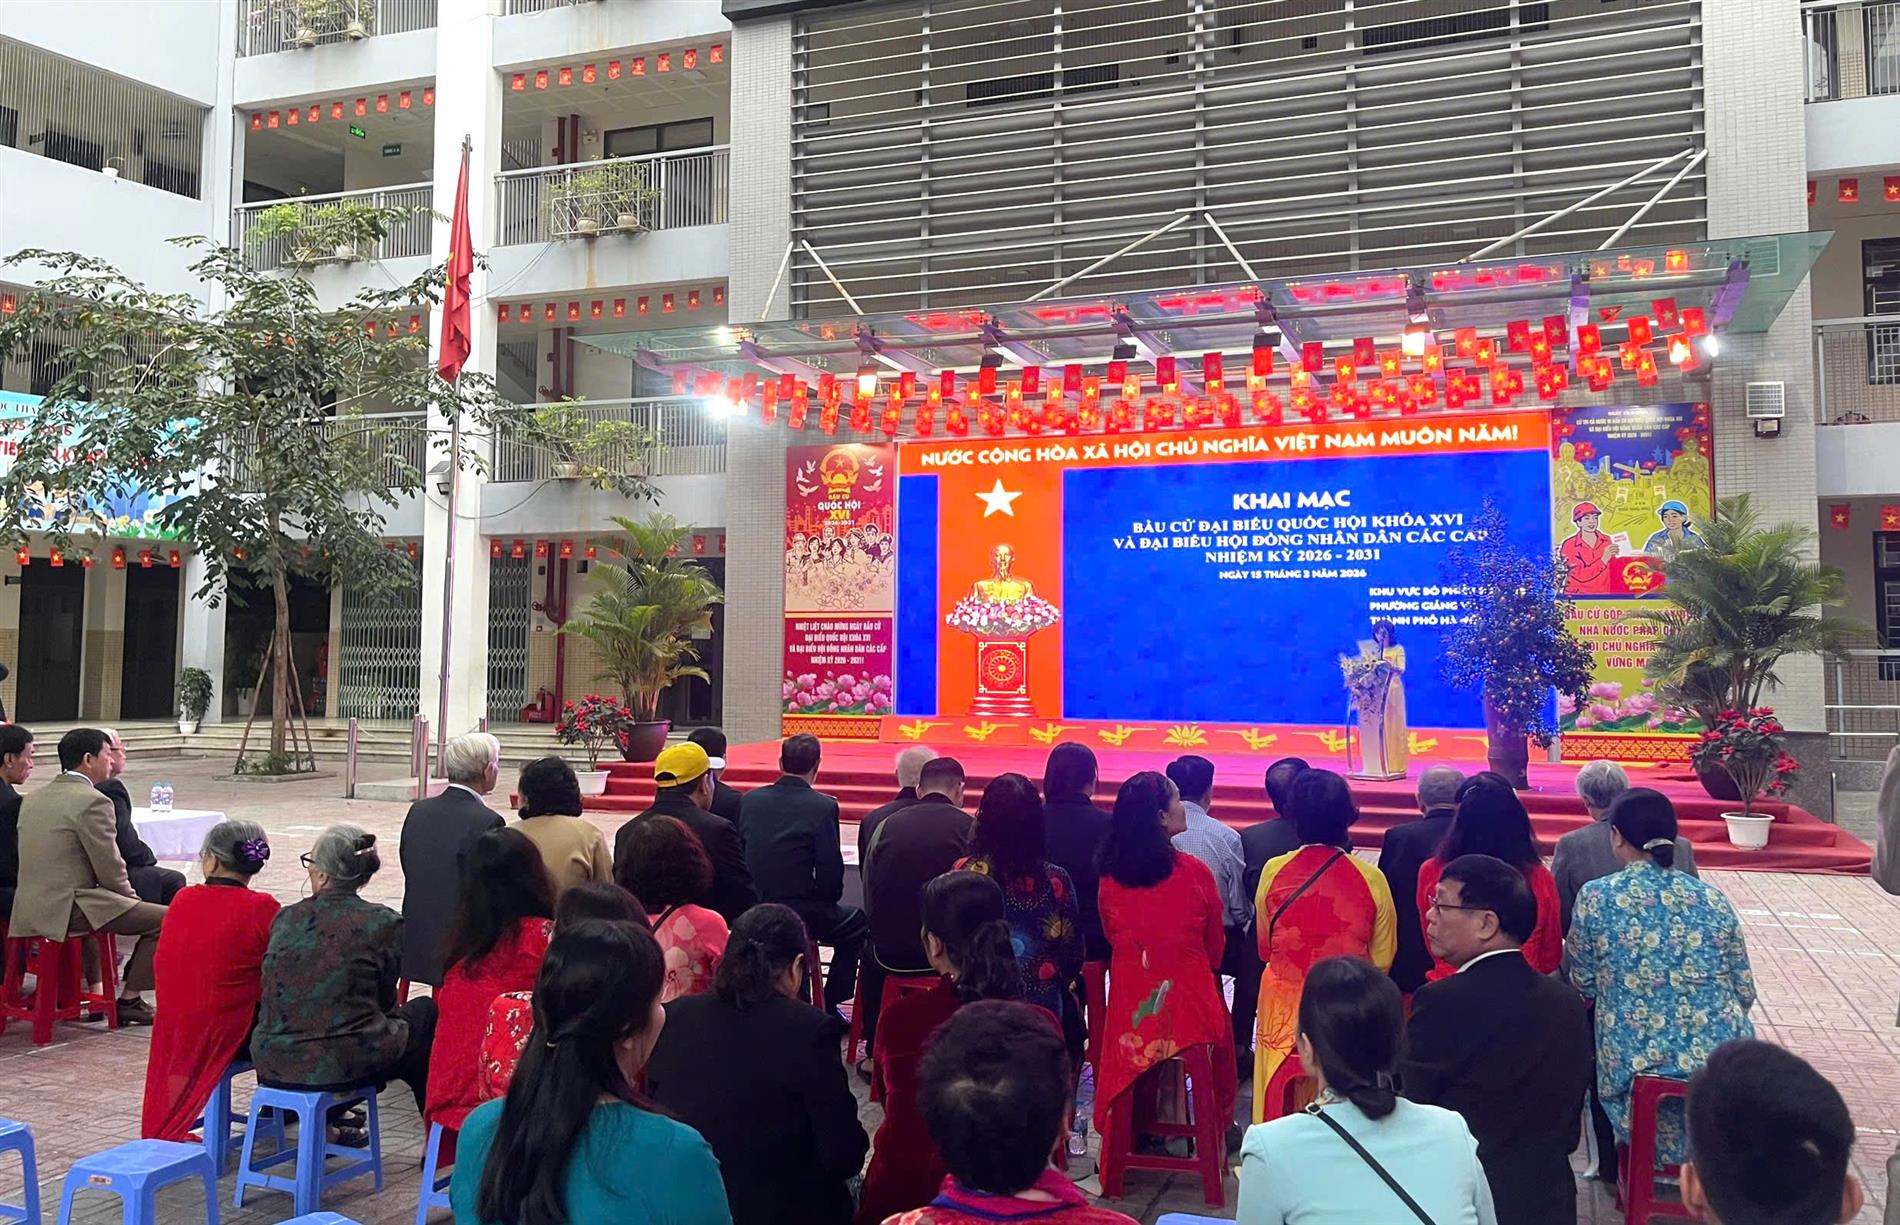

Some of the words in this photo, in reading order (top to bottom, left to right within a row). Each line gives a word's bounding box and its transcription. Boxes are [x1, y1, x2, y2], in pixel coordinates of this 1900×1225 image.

[922, 448, 974, 466] NƯỚC
[978, 447, 1031, 465] CỘNG
[1036, 444, 1078, 462] HÒA
[1082, 443, 1109, 460] XÃ
[1115, 440, 1150, 460] HỘI
[1155, 436, 1198, 456] CHỦ
[1203, 434, 1269, 454] NGHĨA
[1274, 432, 1320, 452] VIỆT
[1325, 432, 1376, 450] NAM
[1380, 426, 1452, 447] MUÔN
[1459, 424, 1518, 443] NĂM!
[818, 500, 842, 511] QUỐC
[844, 500, 861, 511] HỘI
[1233, 492, 1291, 510] KHAI
[1297, 490, 1350, 510] MẠC
[830, 510, 850, 519] XVI
[1170, 518, 1196, 532] CỬ
[1199, 520, 1228, 534] ĐẠI
[1334, 515, 1367, 530] HỘI
[1372, 512, 1426, 528] KHÓA
[1430, 513, 1463, 526] XVI
[1113, 536, 1136, 549] VÀ
[1140, 537, 1168, 551] ĐẠI
[1216, 534, 1248, 549] HỘI
[1308, 530, 1359, 545] NHÂN
[1363, 530, 1401, 544] DÂN
[1406, 528, 1446, 543] CÁC
[1205, 551, 1263, 565] NHIỆM
[1268, 550, 1292, 562] KỲ
[1297, 550, 1332, 562] 2026
[1346, 549, 1380, 560] 2031
[1219, 570, 1248, 580] NGÀY
[1250, 570, 1262, 579] 15
[1264, 568, 1301, 579] THÁNG
[1303, 570, 1310, 578] 3
[1312, 568, 1338, 578] NĂM
[1340, 569, 1367, 578] 2026
[1369, 587, 1395, 596] KHU
[1396, 586, 1421, 597] VỰC
[1369, 600, 1419, 611] PHƯỜNG
[1587, 605, 1600, 619] CỬ
[1603, 605, 1623, 619] GÓP
[1602, 621, 1630, 636] NƯỚC
[1602, 638, 1622, 651] CHỦ
[1606, 656, 1633, 668] VỮNG
